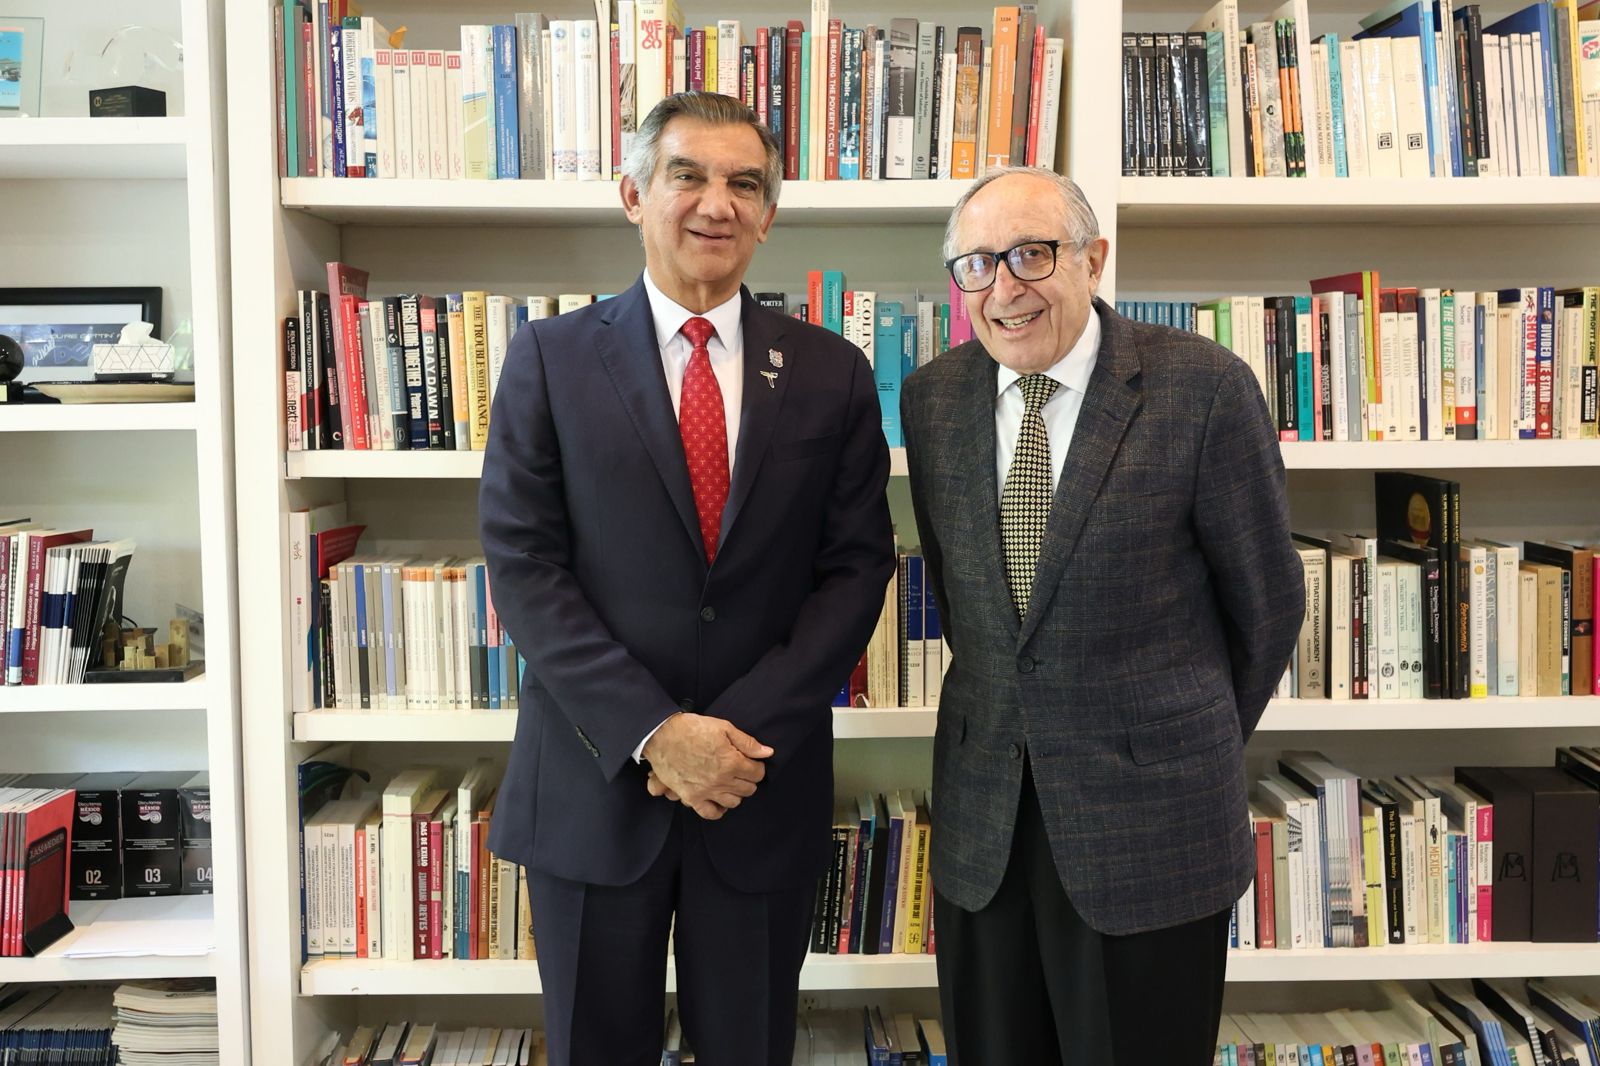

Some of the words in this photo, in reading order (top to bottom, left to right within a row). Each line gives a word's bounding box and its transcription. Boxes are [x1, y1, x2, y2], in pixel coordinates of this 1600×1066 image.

[401, 297, 419, 347] LEGISLATING
[862, 299, 871, 349] COLIN
[1443, 306, 1454, 322] THE
[425, 336, 436, 375] GRAY
[474, 323, 486, 368] TROUBLE
[1444, 325, 1454, 369] UNIVERSE
[1541, 324, 1551, 357] DIVIDED
[405, 349, 422, 387] TOGETHER
[1444, 372, 1454, 383] OF
[1540, 360, 1551, 372] WE
[427, 376, 439, 419] DAWN
[1539, 375, 1551, 403] STAND
[287, 400, 298, 422] next?
[477, 389, 488, 429] FRANCE
[1460, 602, 1468, 652] Beeronomics
[420, 822, 428, 835] DÍAS
[420, 837, 428, 845] DE
[420, 846, 428, 867] EXILIO
[1430, 846, 1440, 877] MEXICO
[85, 870, 102, 884] 02
[145, 868, 161, 883] 03
